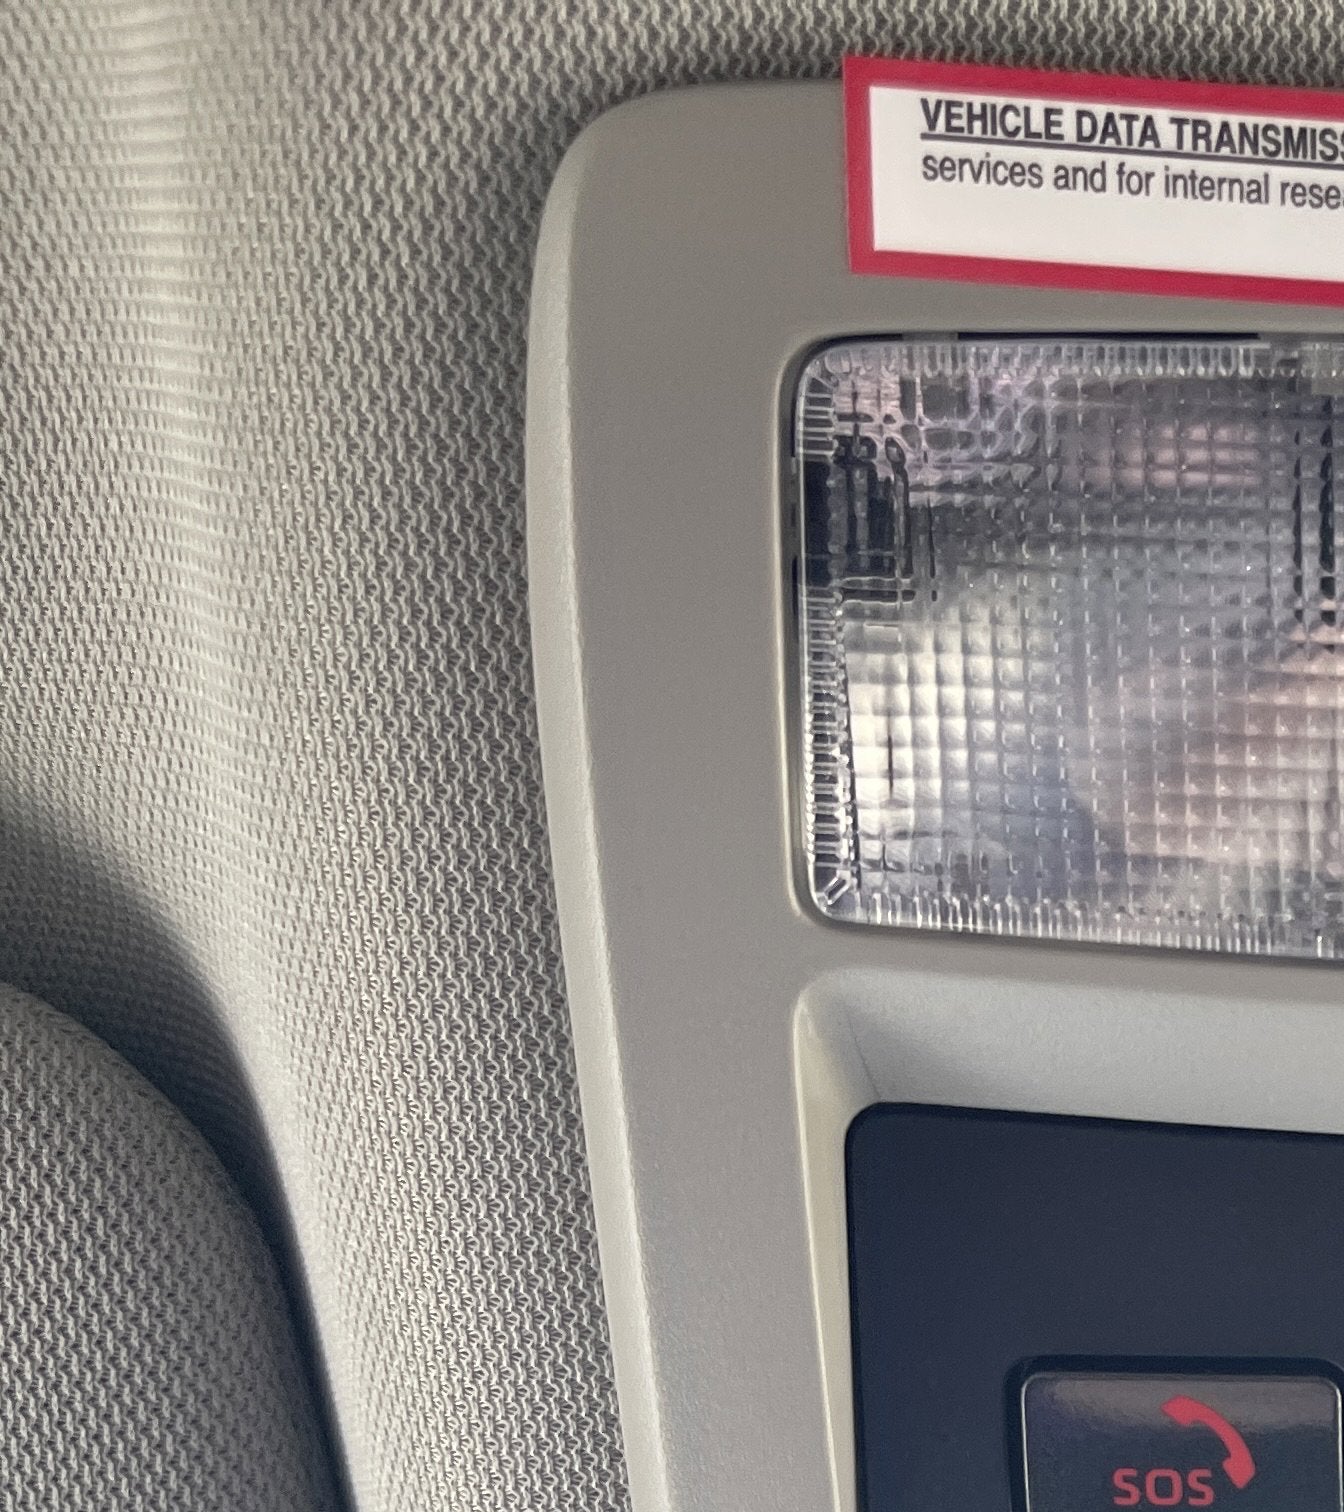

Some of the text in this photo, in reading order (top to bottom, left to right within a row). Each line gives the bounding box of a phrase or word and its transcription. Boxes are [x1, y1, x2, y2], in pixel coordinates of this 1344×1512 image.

[921, 99, 1064, 144] VEHICLE
[1076, 108, 1160, 149] DATA
[922, 152, 1043, 188] services
[1053, 160, 1106, 193] and
[1116, 162, 1155, 196] for
[1164, 165, 1269, 204] internal
[1112, 1468, 1215, 1506] SOS
